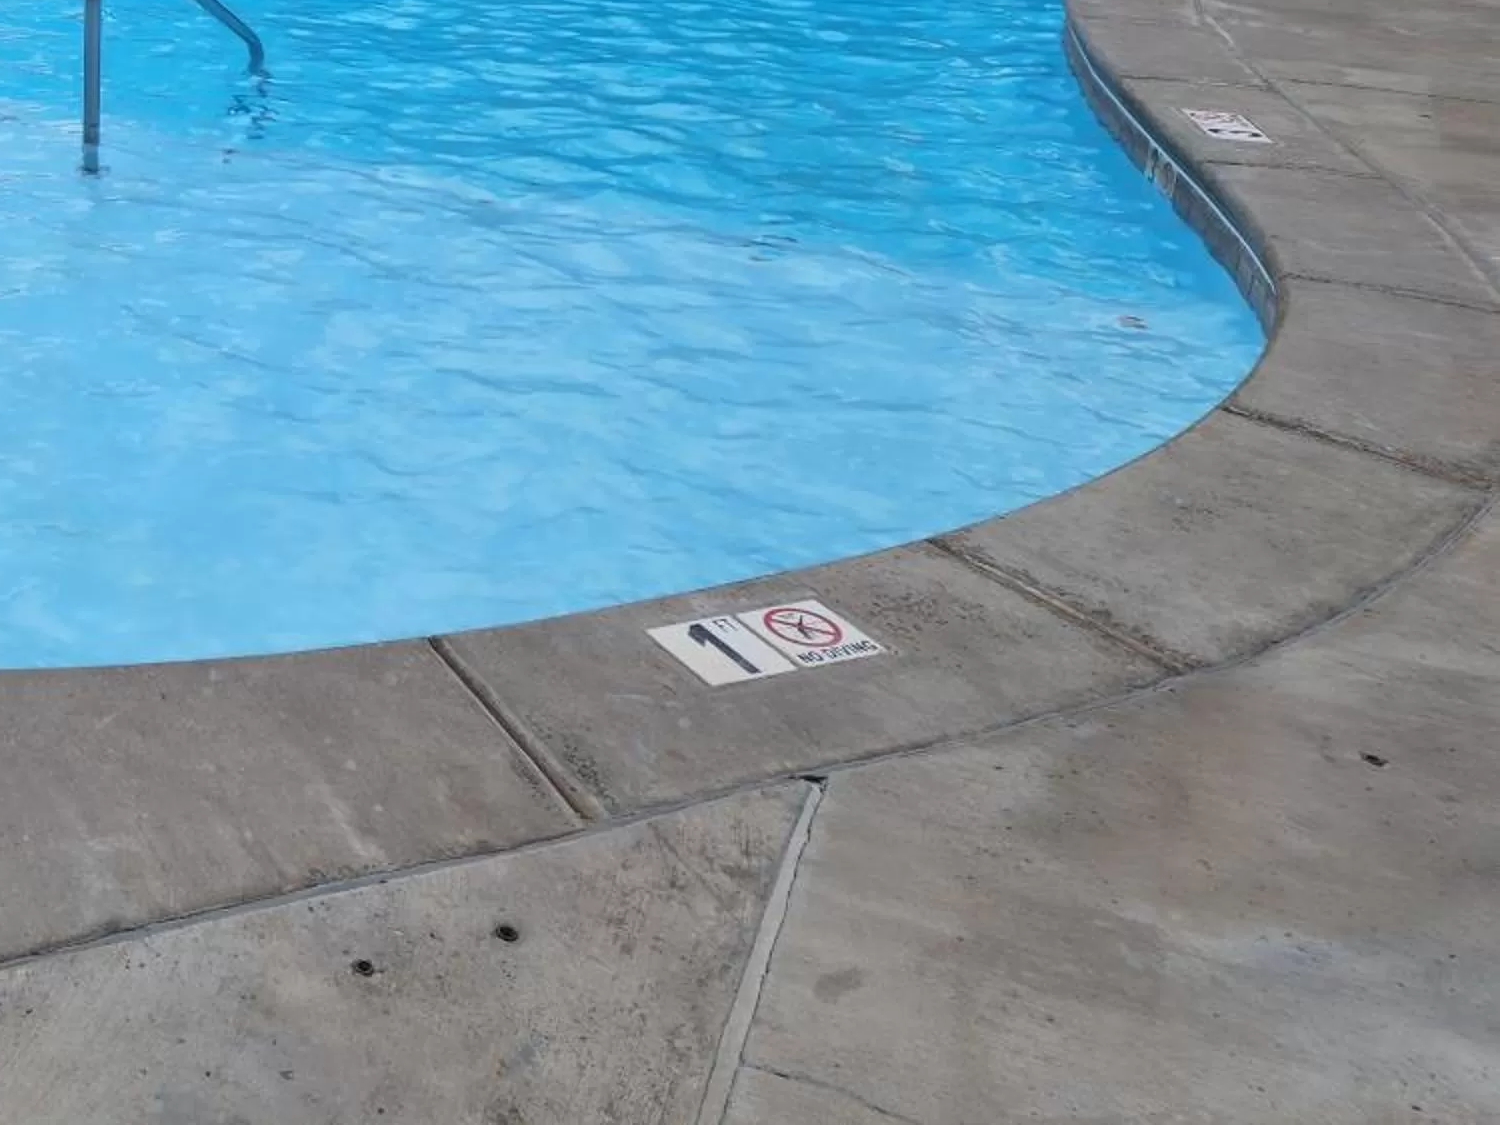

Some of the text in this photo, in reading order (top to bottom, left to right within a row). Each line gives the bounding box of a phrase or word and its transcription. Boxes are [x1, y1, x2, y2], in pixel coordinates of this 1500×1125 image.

[688, 623, 761, 674] 1
[798, 640, 877, 664] NO DIVING
